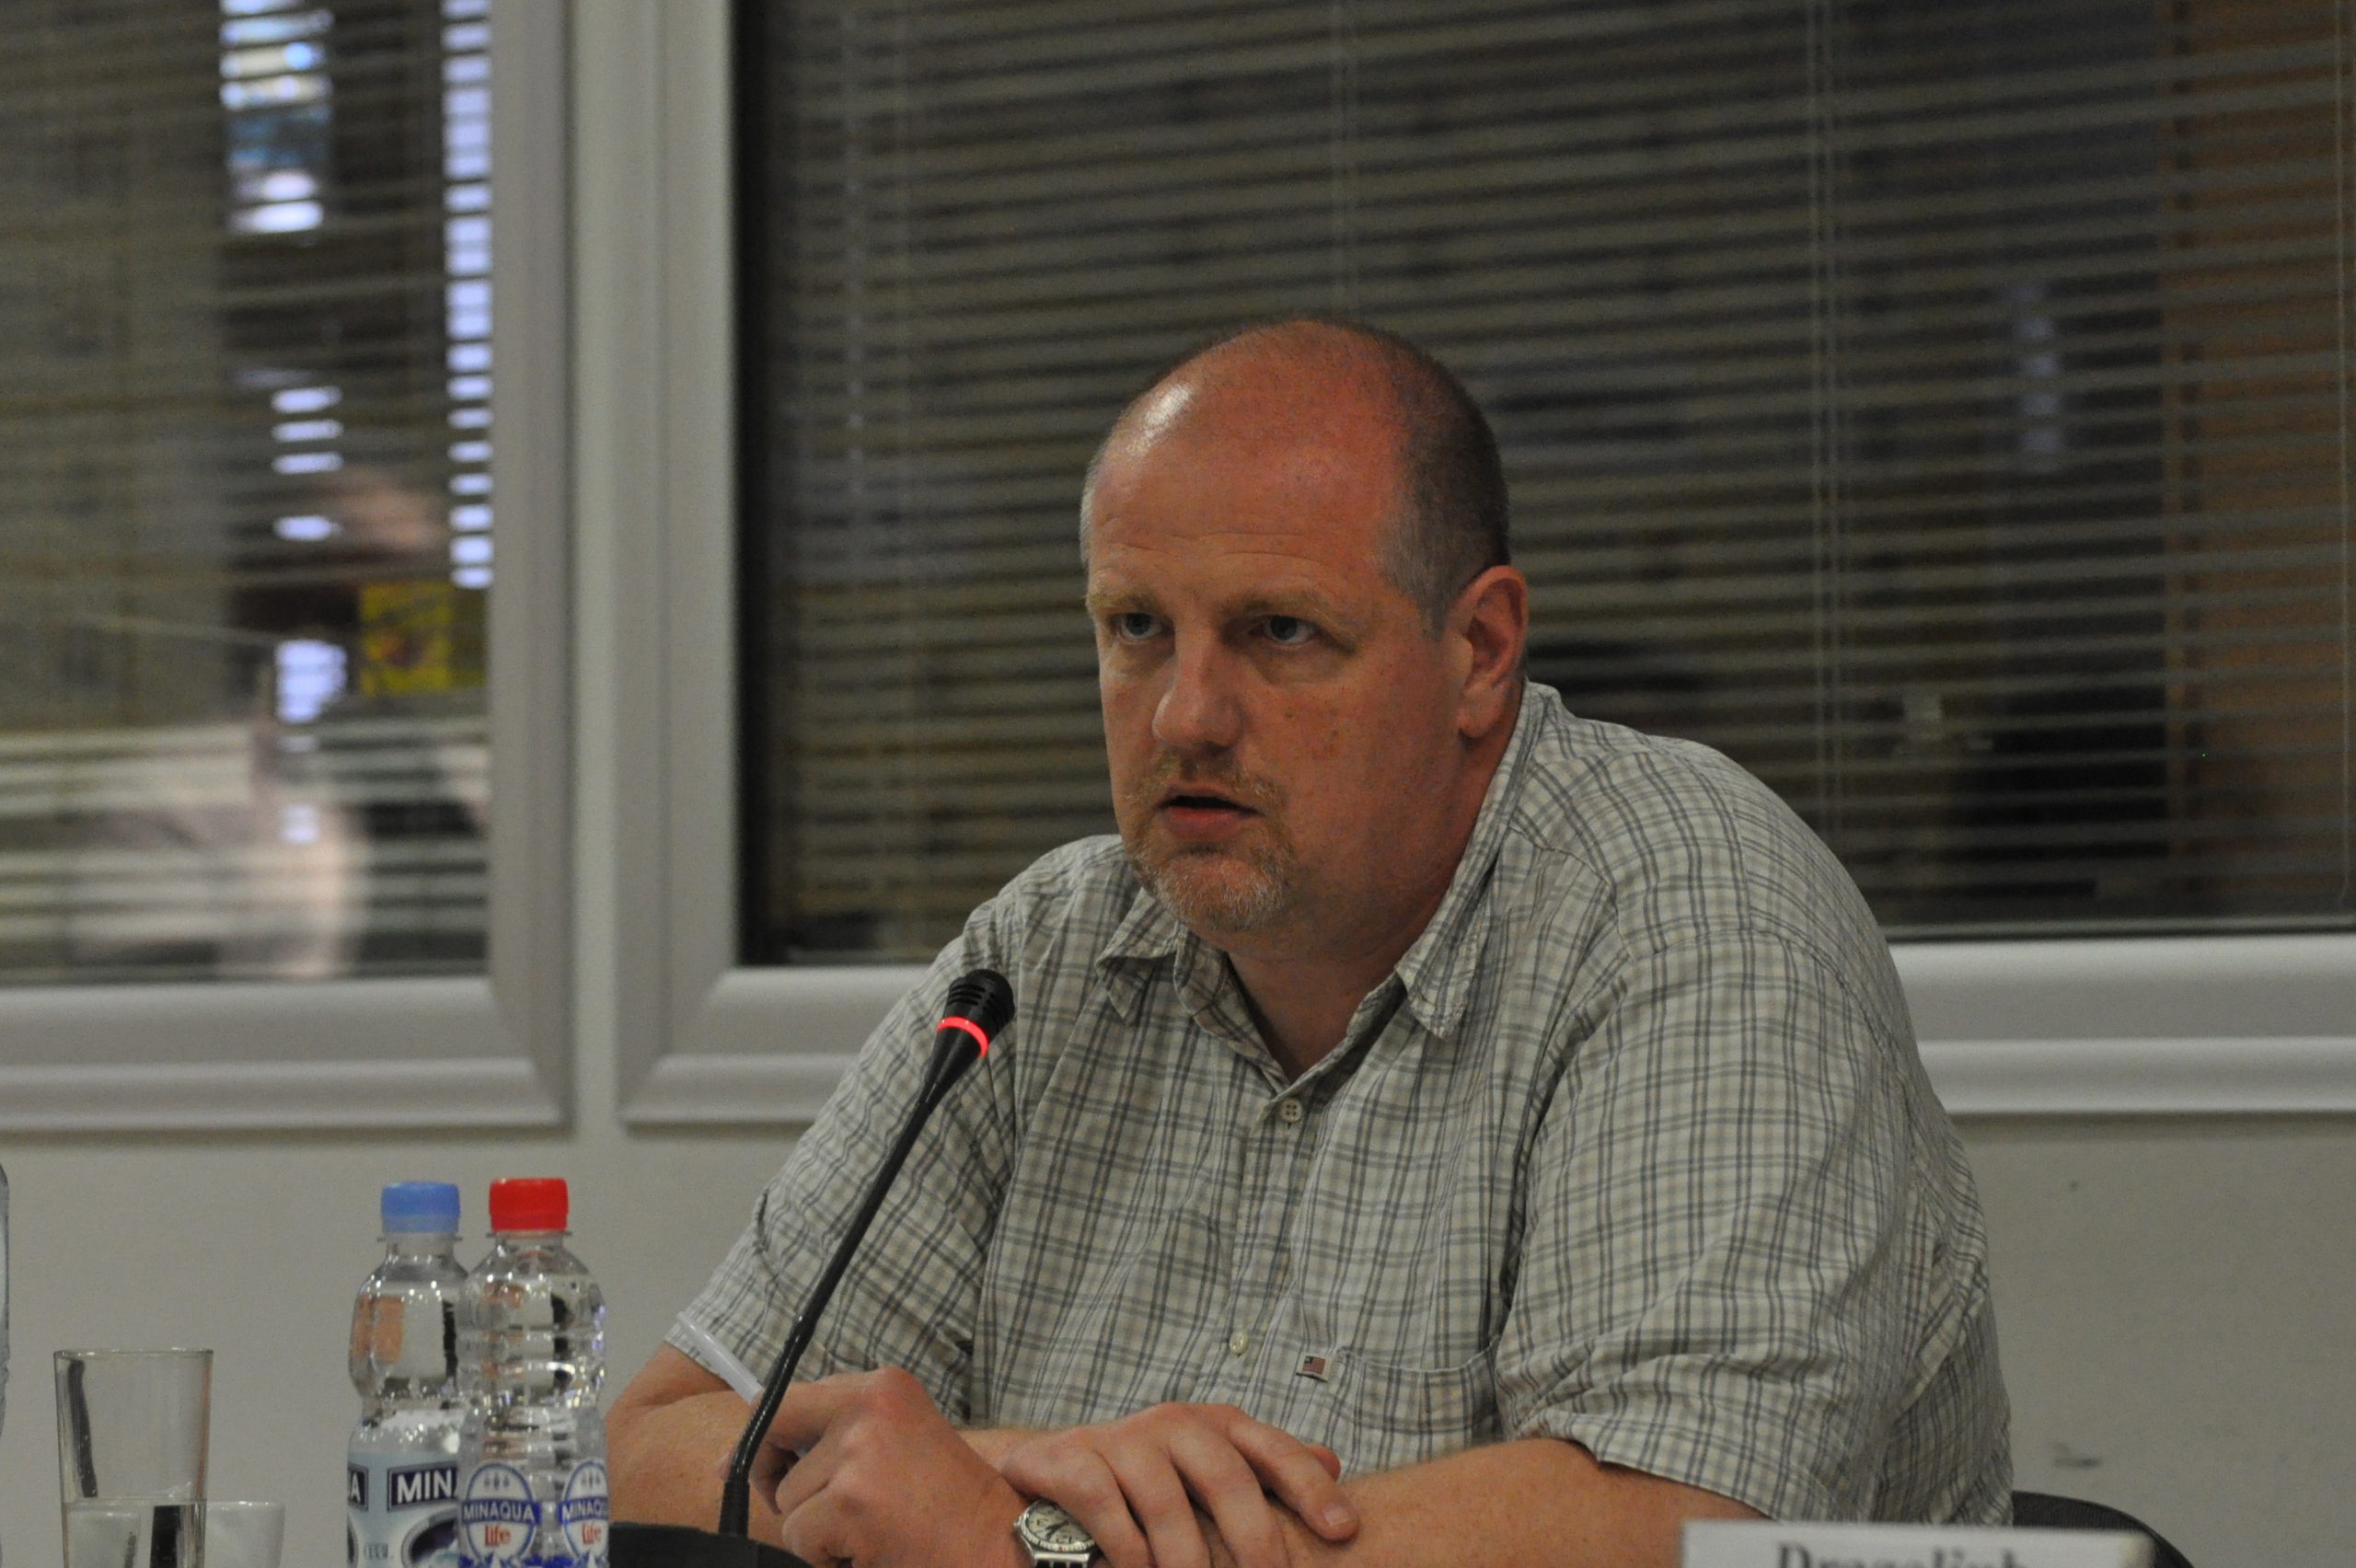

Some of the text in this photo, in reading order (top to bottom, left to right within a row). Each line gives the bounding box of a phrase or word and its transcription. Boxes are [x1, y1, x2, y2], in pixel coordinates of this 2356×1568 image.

[397, 1469, 457, 1504] MIN
[464, 1502, 535, 1523] MINAQUA
[485, 1526, 510, 1546] life
[583, 1524, 601, 1544] life
